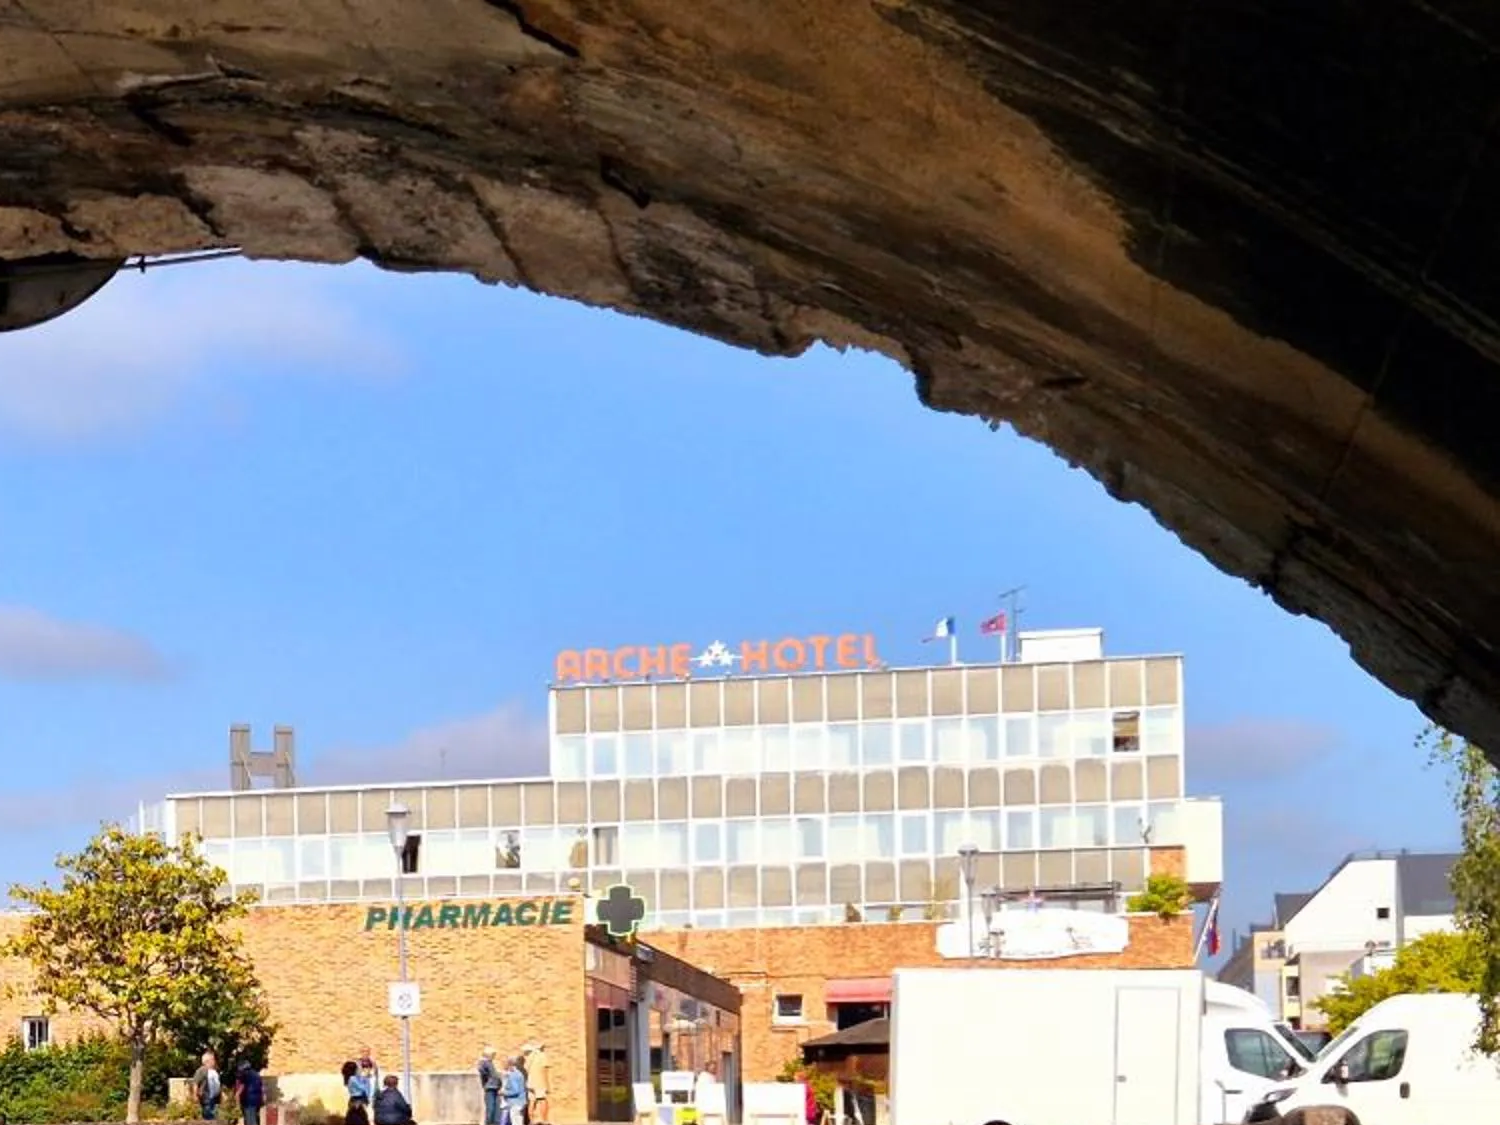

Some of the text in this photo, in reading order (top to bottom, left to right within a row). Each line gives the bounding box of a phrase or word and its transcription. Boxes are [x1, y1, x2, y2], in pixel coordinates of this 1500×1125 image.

[555, 632, 881, 681] ARCHE HOTEL
[364, 900, 575, 932] PHARMACIE
